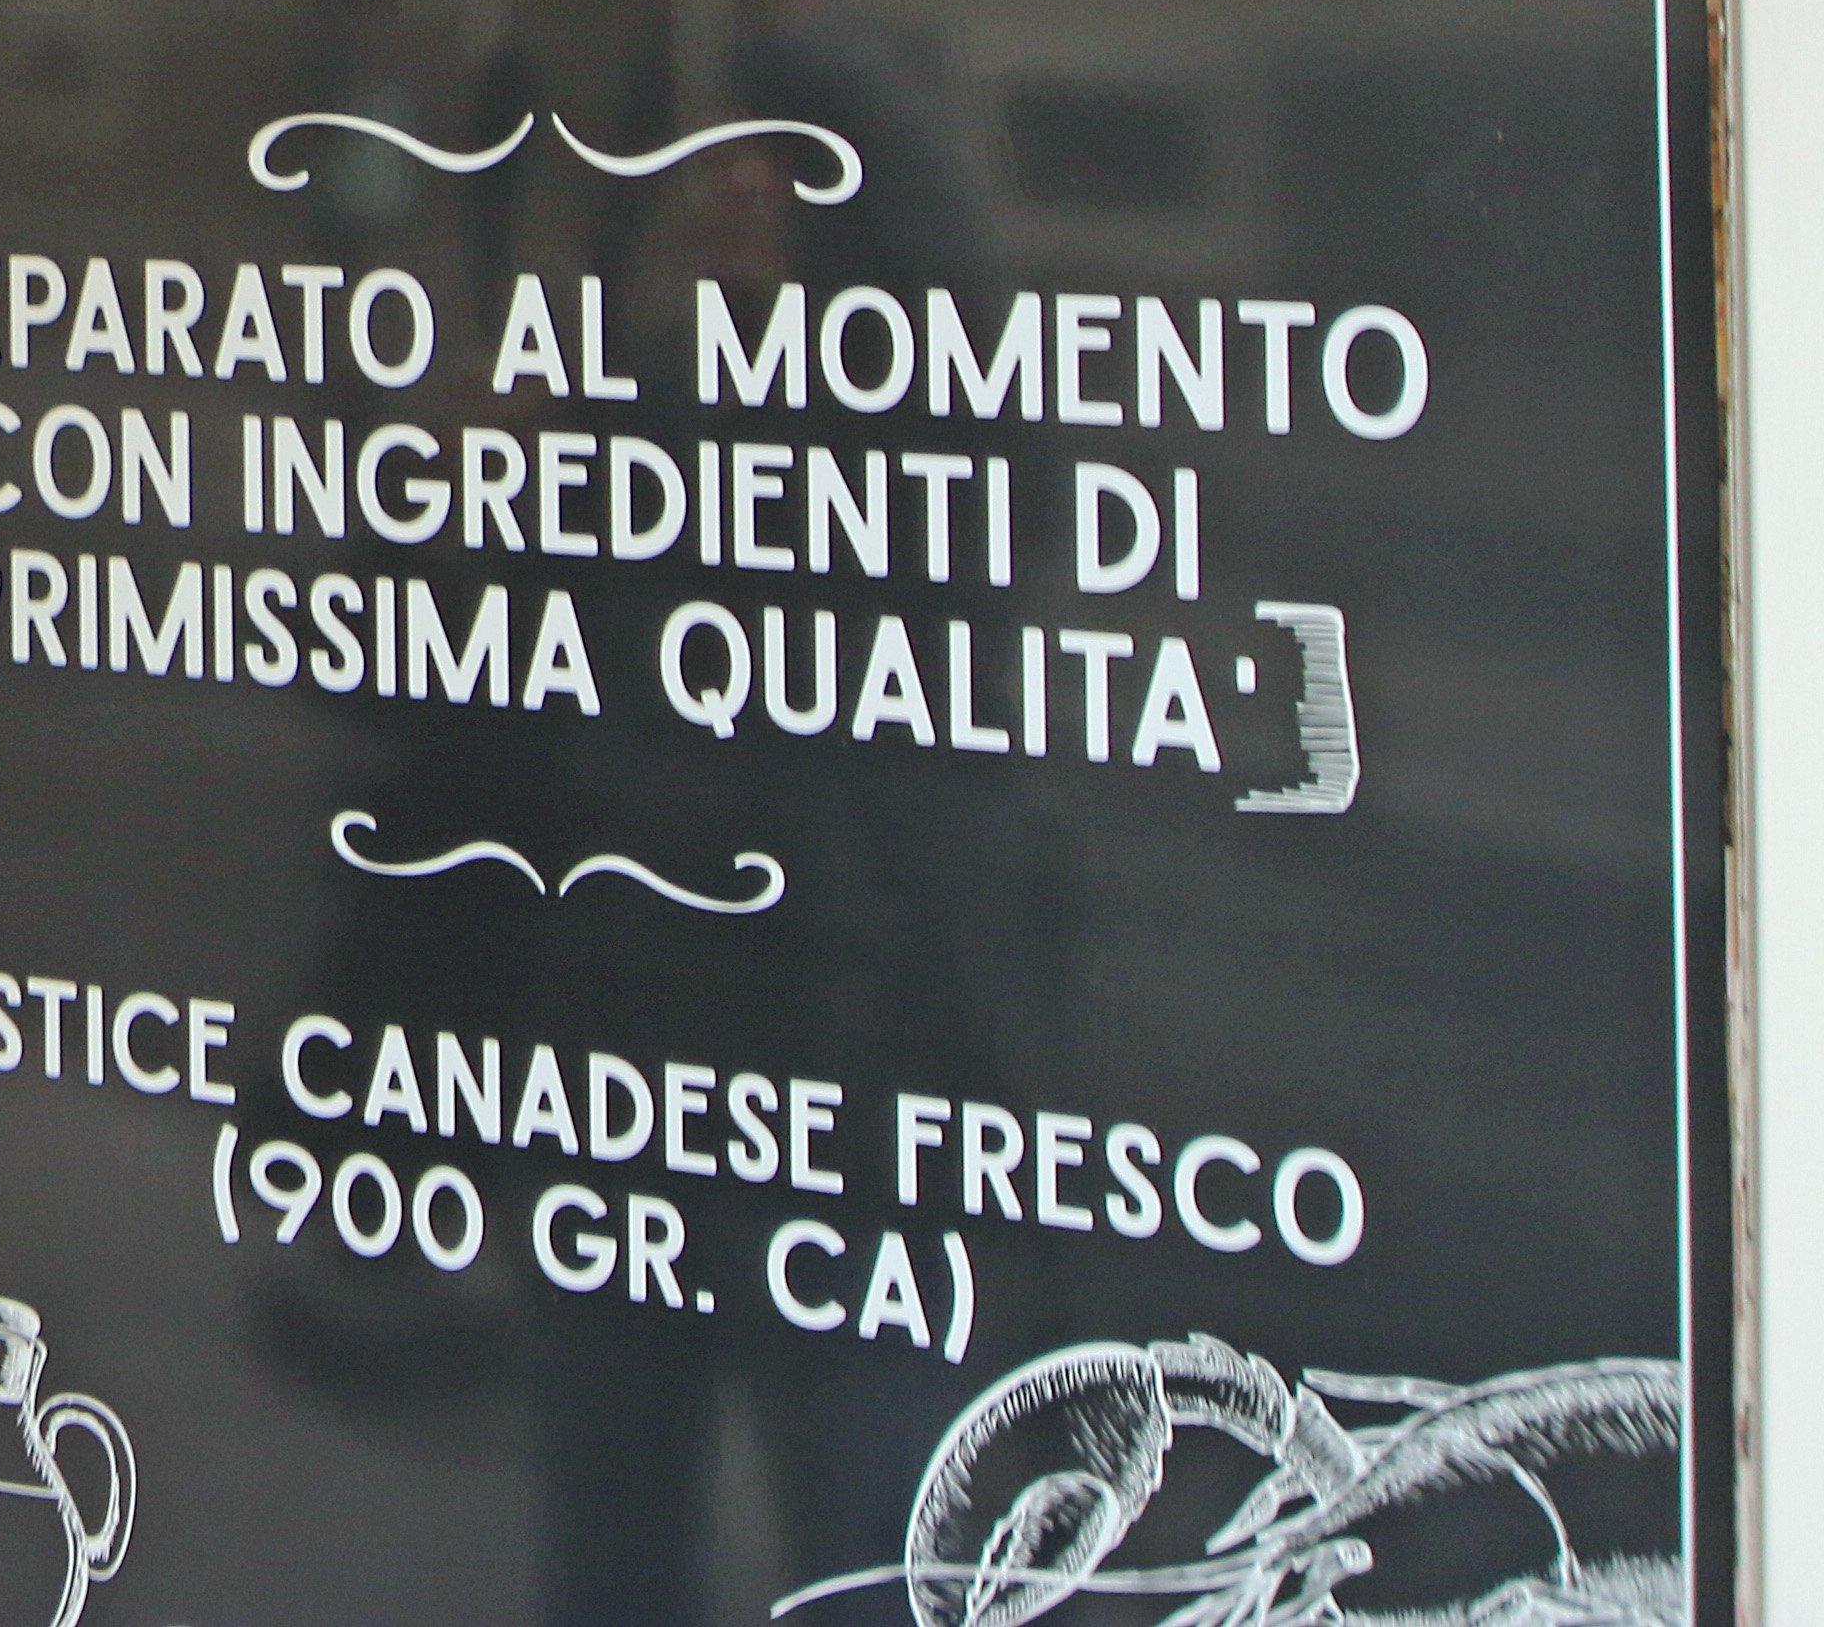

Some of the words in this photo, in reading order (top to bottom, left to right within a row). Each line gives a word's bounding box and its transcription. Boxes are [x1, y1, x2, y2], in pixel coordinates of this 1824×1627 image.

[493, 274, 637, 399] AL
[697, 280, 1427, 439] MOMENTO
[243, 415, 1010, 586] INGREDIENTI
[1076, 463, 1198, 599] DI
[660, 602, 1255, 771] QUALITA'
[282, 1015, 843, 1193] CANADESE
[898, 1094, 1363, 1264] FRESCO
[213, 1123, 483, 1270] (900
[532, 1184, 714, 1312] GR.
[767, 1220, 973, 1363] CA)
